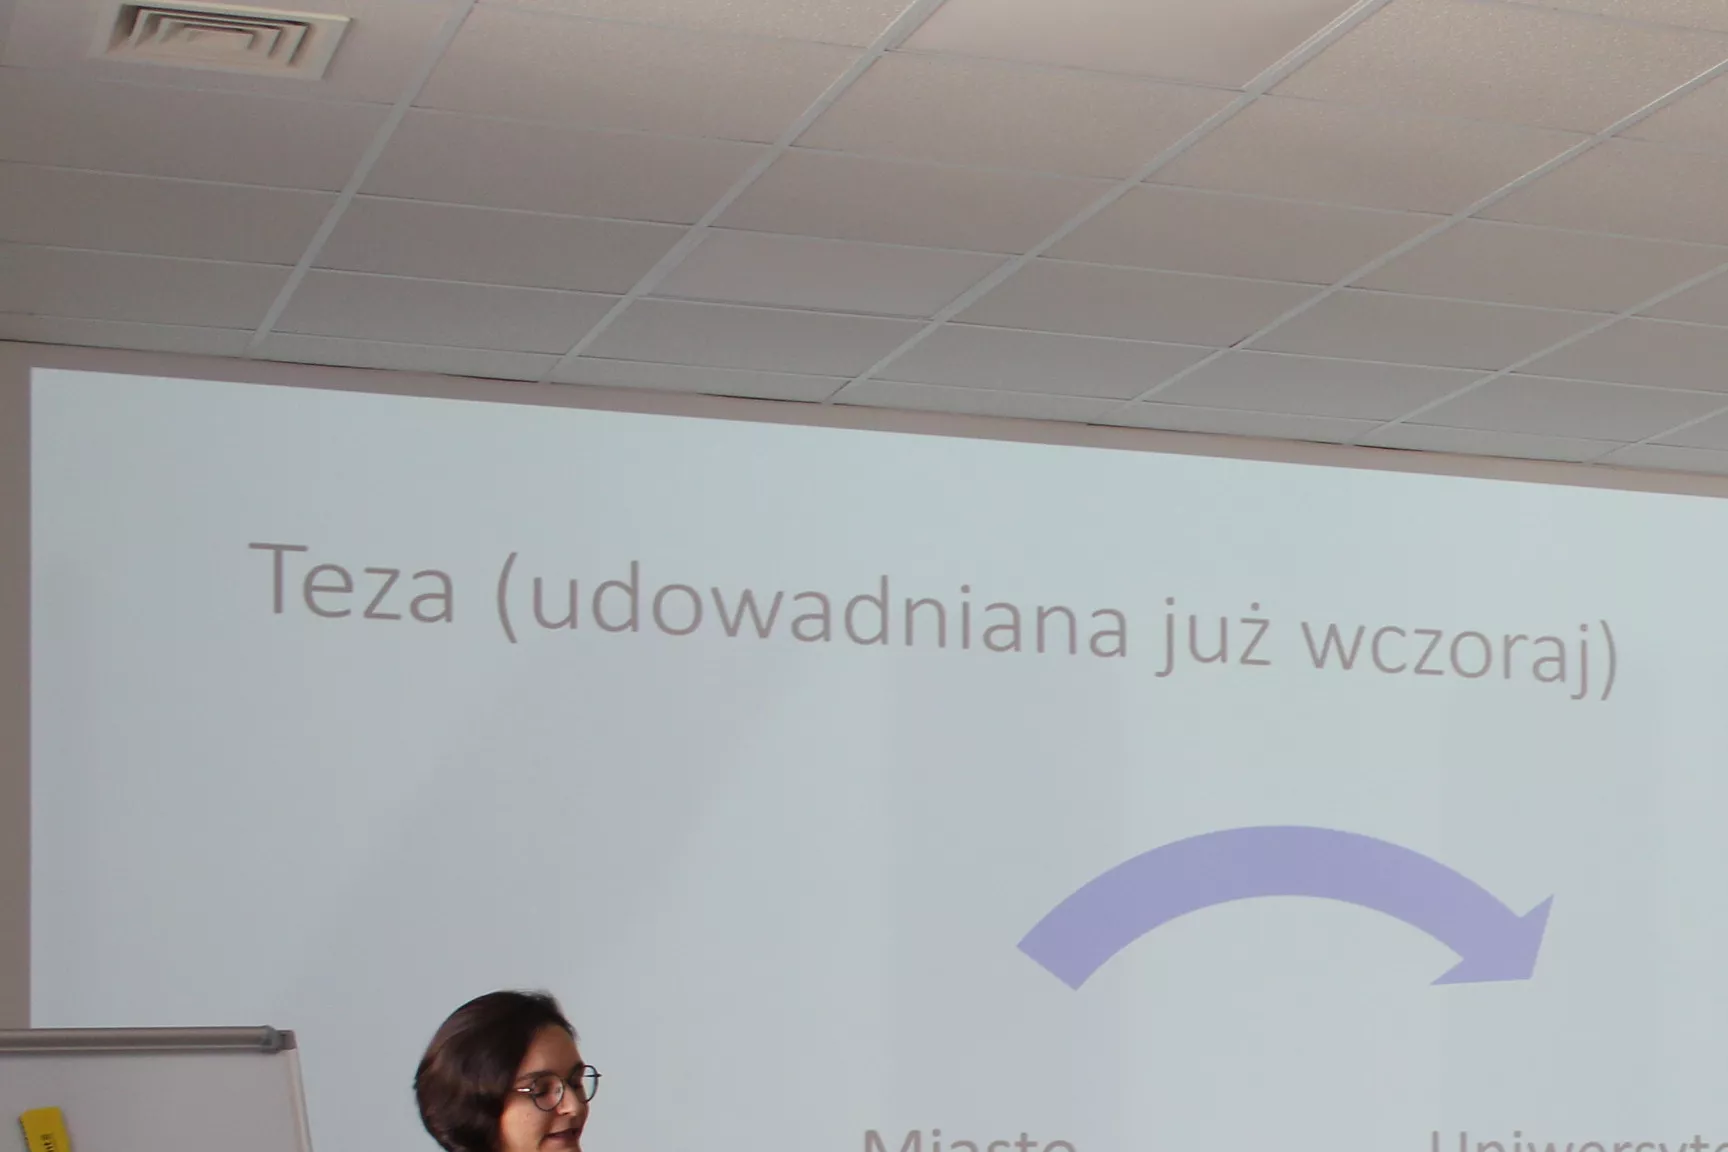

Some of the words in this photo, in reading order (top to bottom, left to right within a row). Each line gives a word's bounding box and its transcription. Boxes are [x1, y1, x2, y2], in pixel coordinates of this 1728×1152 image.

[248, 541, 456, 624] Teza
[495, 551, 1128, 659] (udowadniana
[1155, 596, 1271, 678] już
[1300, 619, 1617, 701] wczoraj)
